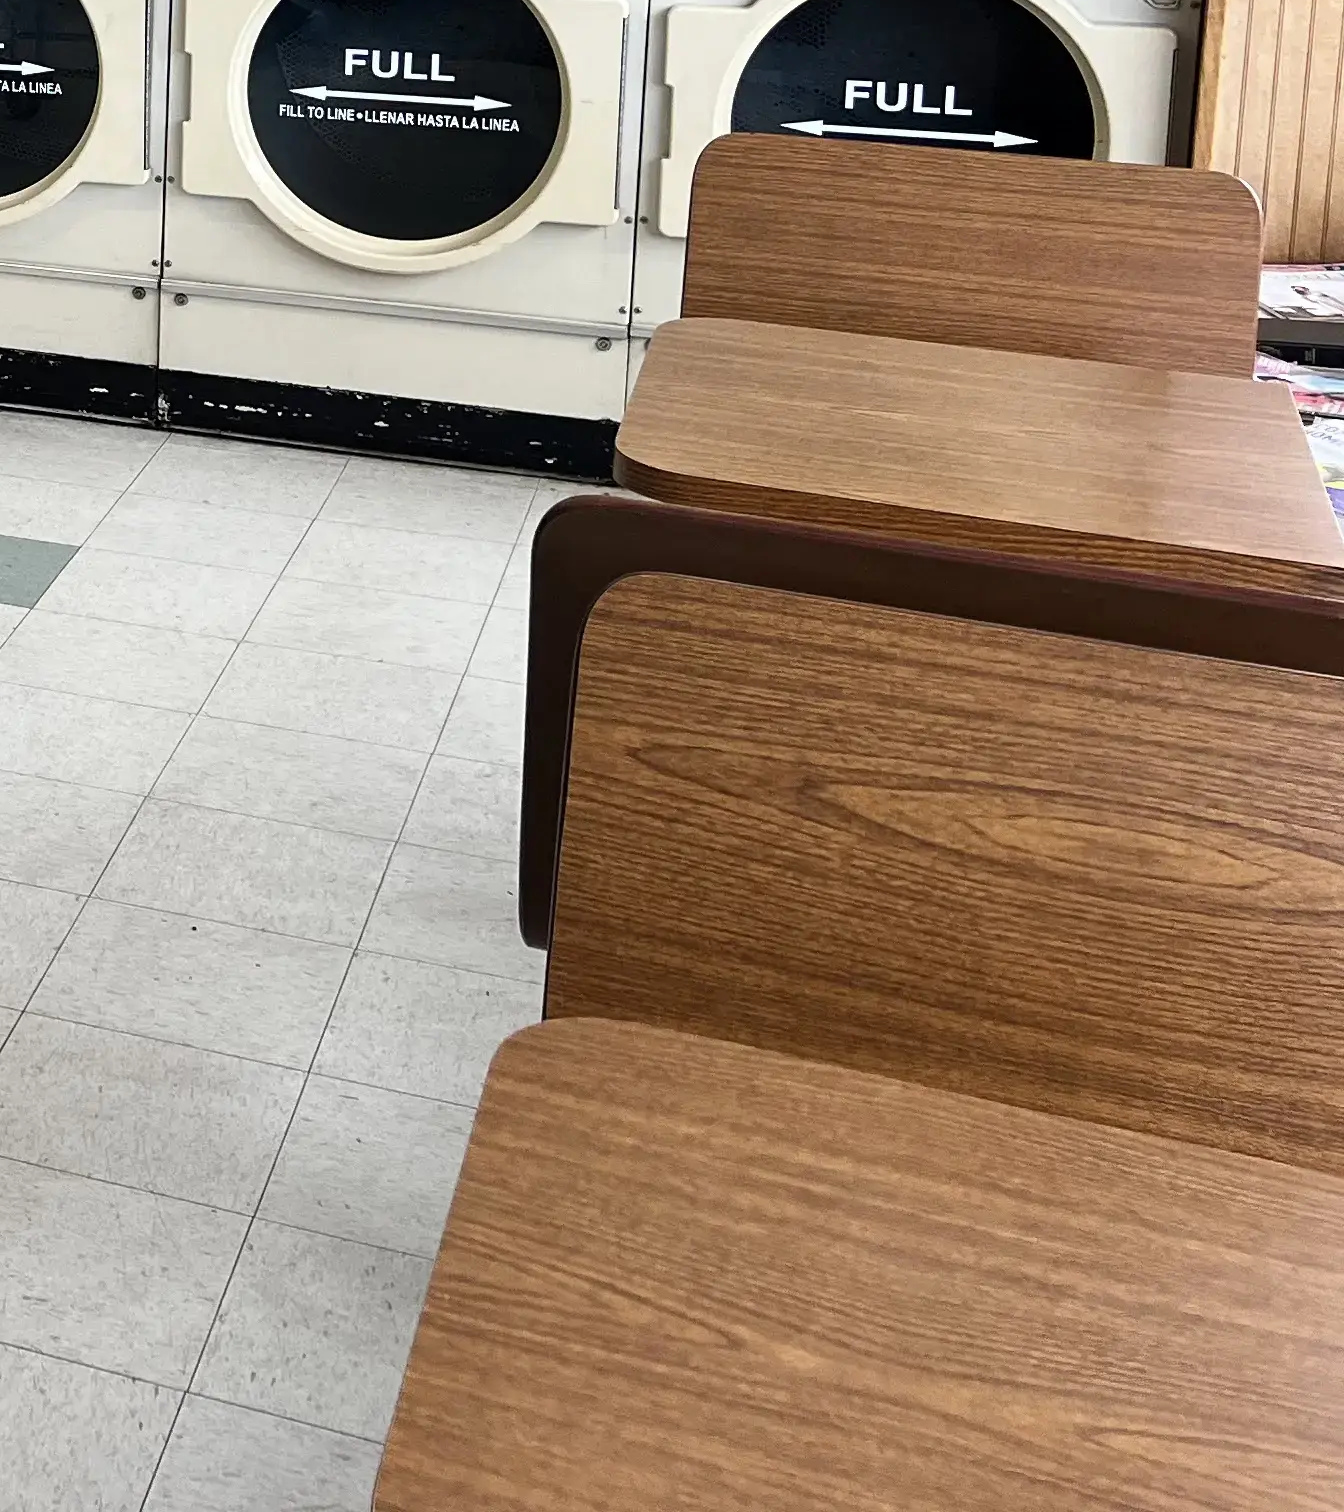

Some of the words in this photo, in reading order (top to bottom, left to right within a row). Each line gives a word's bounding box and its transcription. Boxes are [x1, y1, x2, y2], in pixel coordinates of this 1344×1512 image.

[345, 49, 455, 81] FULL
[11, 82, 26, 92] LA
[28, 82, 62, 94] LINEA
[845, 80, 972, 115] FULL
[279, 107, 304, 117] FILL
[307, 108, 324, 119] TO
[417, 114, 459, 128] HASTA
[462, 117, 479, 129] LA
[481, 118, 519, 131] LINEA
